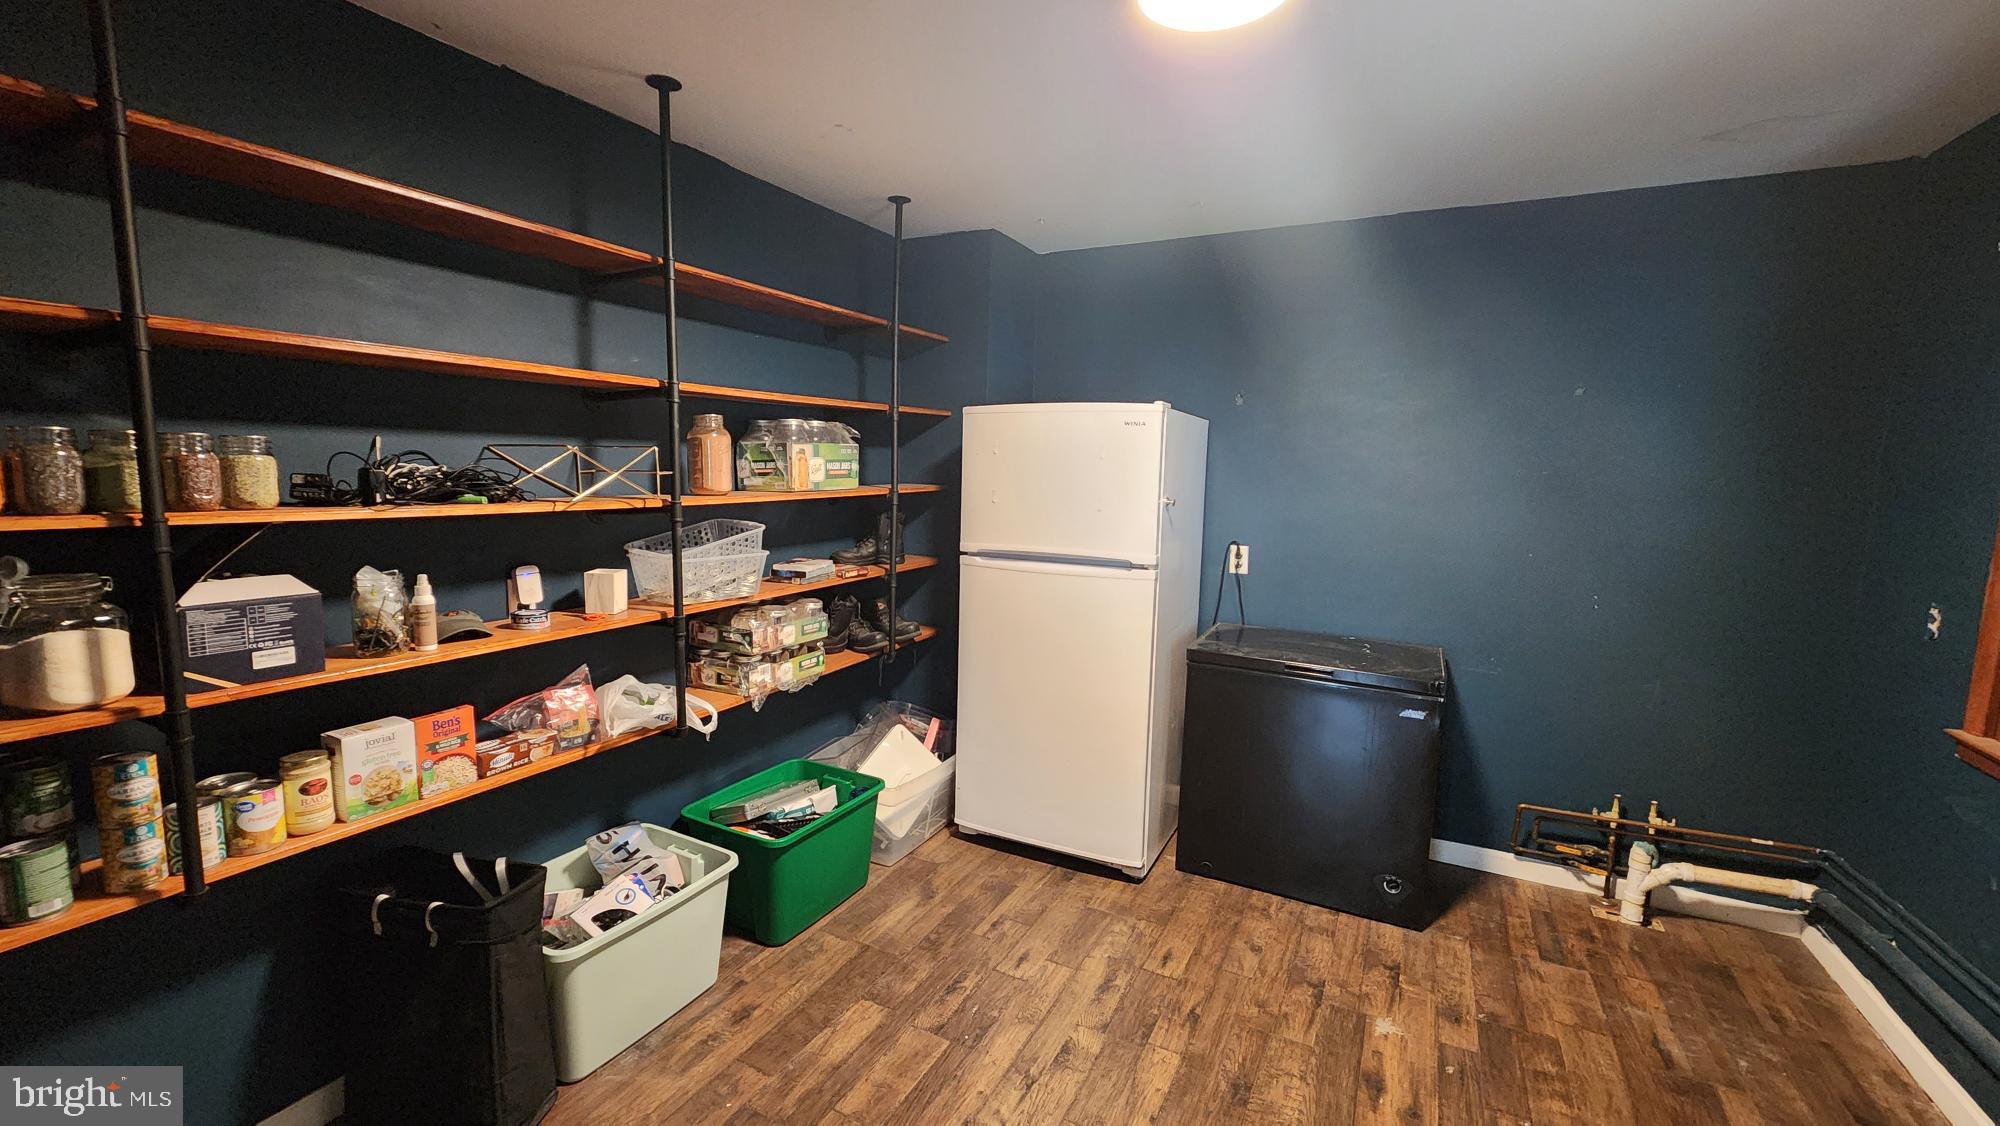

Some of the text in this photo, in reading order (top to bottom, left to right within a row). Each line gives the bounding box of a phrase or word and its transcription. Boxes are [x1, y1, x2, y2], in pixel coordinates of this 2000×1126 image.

[432, 716, 461, 731] Ben's
[365, 732, 396, 750] jovial
[486, 757, 529, 777] BROWN RICE
